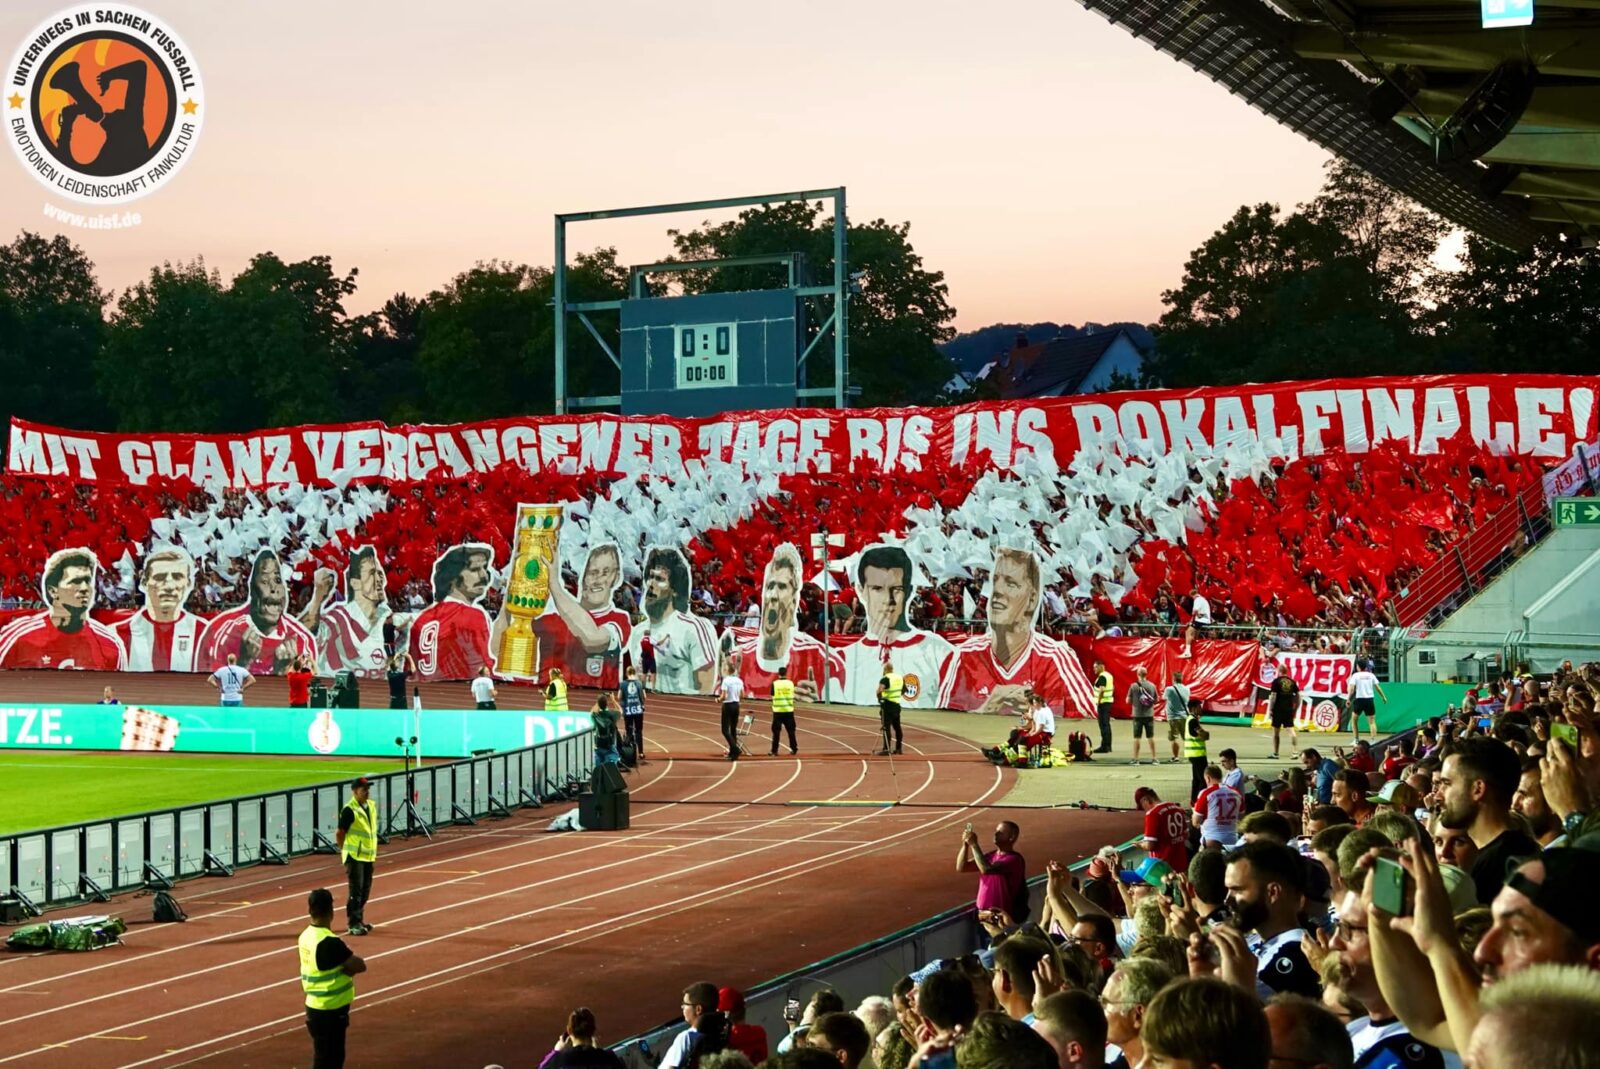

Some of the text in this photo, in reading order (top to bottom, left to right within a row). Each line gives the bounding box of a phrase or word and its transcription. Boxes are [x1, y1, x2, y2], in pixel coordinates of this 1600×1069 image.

[9, 385, 1594, 488] MIT GLANZ VERGANGENER TAGE BIS INS POKALFINALE!
[418, 620, 440, 676] 9
[0, 708, 73, 744] TZE.
[1167, 812, 1183, 837] 69
[1216, 798, 1238, 820] 12
